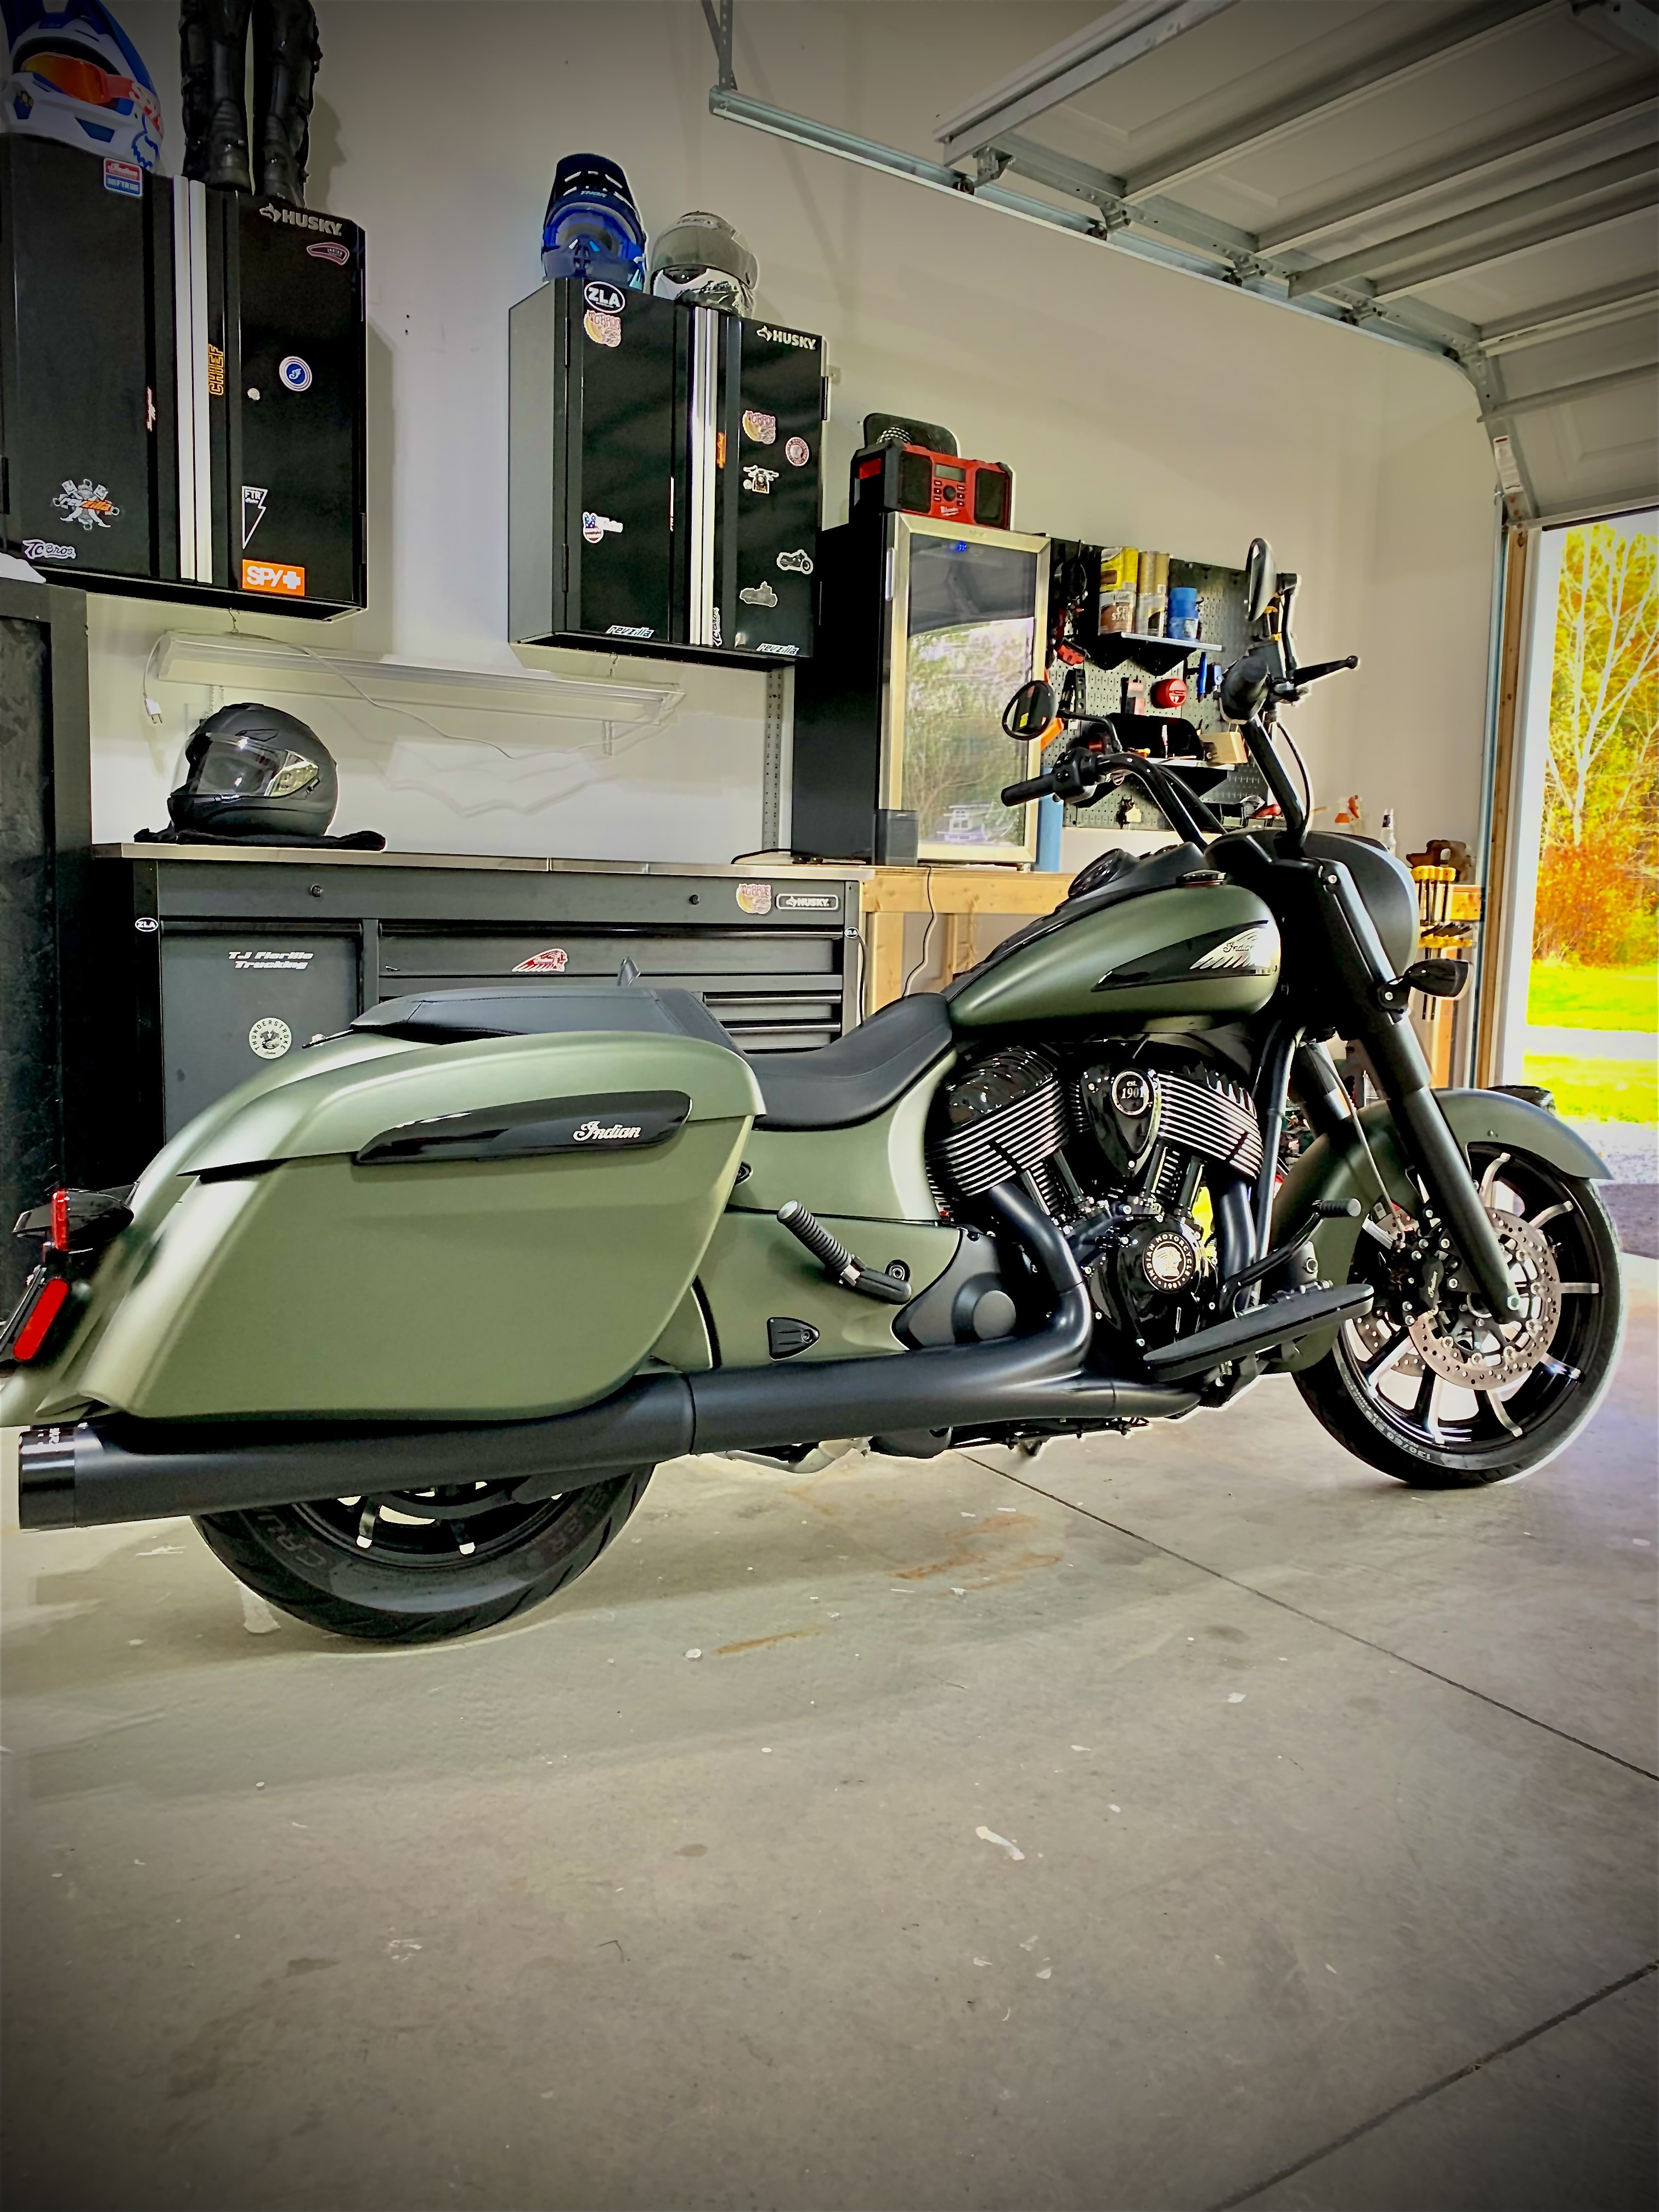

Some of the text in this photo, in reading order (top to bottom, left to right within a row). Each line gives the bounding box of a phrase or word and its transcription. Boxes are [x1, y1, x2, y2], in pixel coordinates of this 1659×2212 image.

[588, 287, 621, 308] ZLA
[208, 343, 224, 395] CHIEF
[1112, 613, 1132, 621] STAI
[607, 625, 653, 638] revzilla
[757, 644, 799, 656] revzilla
[228, 951, 252, 960] TJ
[234, 961, 308, 969] Trucking
[252, 1020, 289, 1051] THUNDERSTROKE
[1120, 1087, 1143, 1099] 1901
[573, 1121, 641, 1141] Indian
[1146, 1234, 1192, 1281] INDIAN MOTORCYCLE
[1164, 1281, 1181, 1289] 1901
